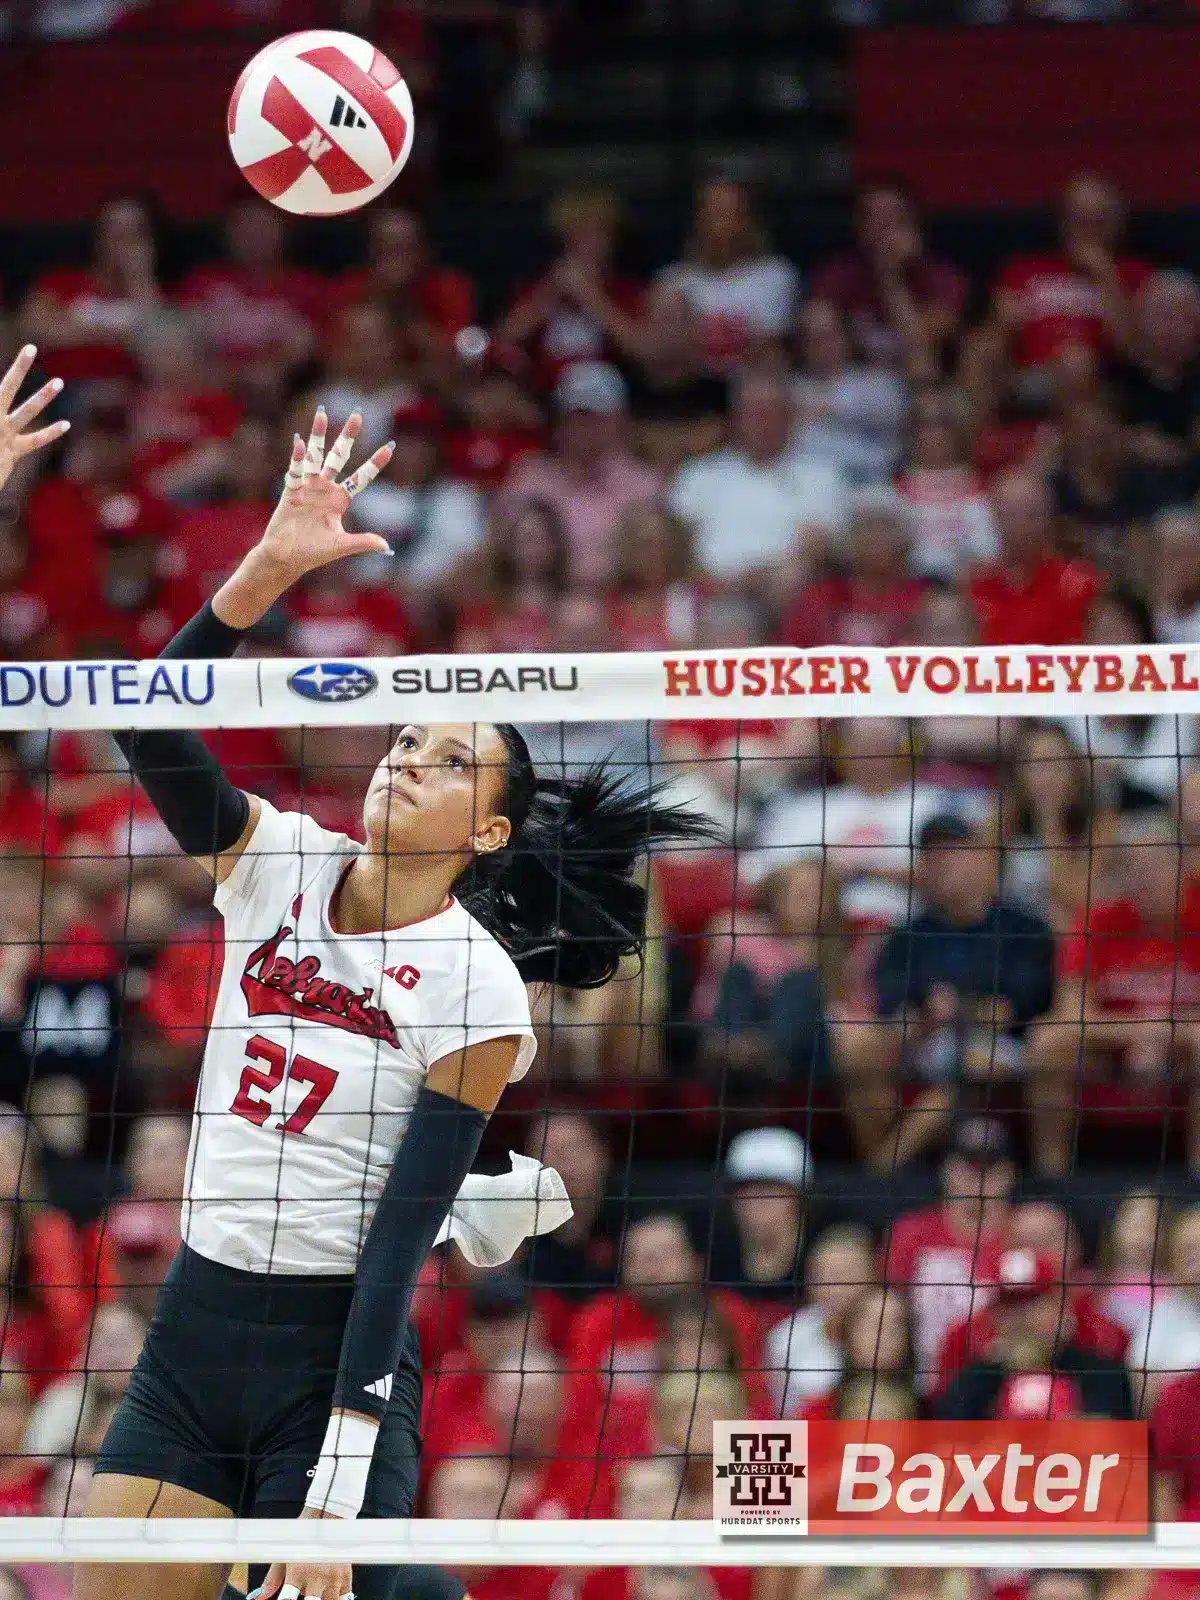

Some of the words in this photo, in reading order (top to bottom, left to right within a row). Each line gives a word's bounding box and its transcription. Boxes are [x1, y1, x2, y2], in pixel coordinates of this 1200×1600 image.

[297, 127, 333, 163] N
[0, 664, 216, 708] DUTEAU
[391, 665, 579, 695] SUBARU
[662, 656, 872, 698] HUSKER
[885, 652, 1199, 695] VOLLEYBAL
[228, 1033, 340, 1135] 27
